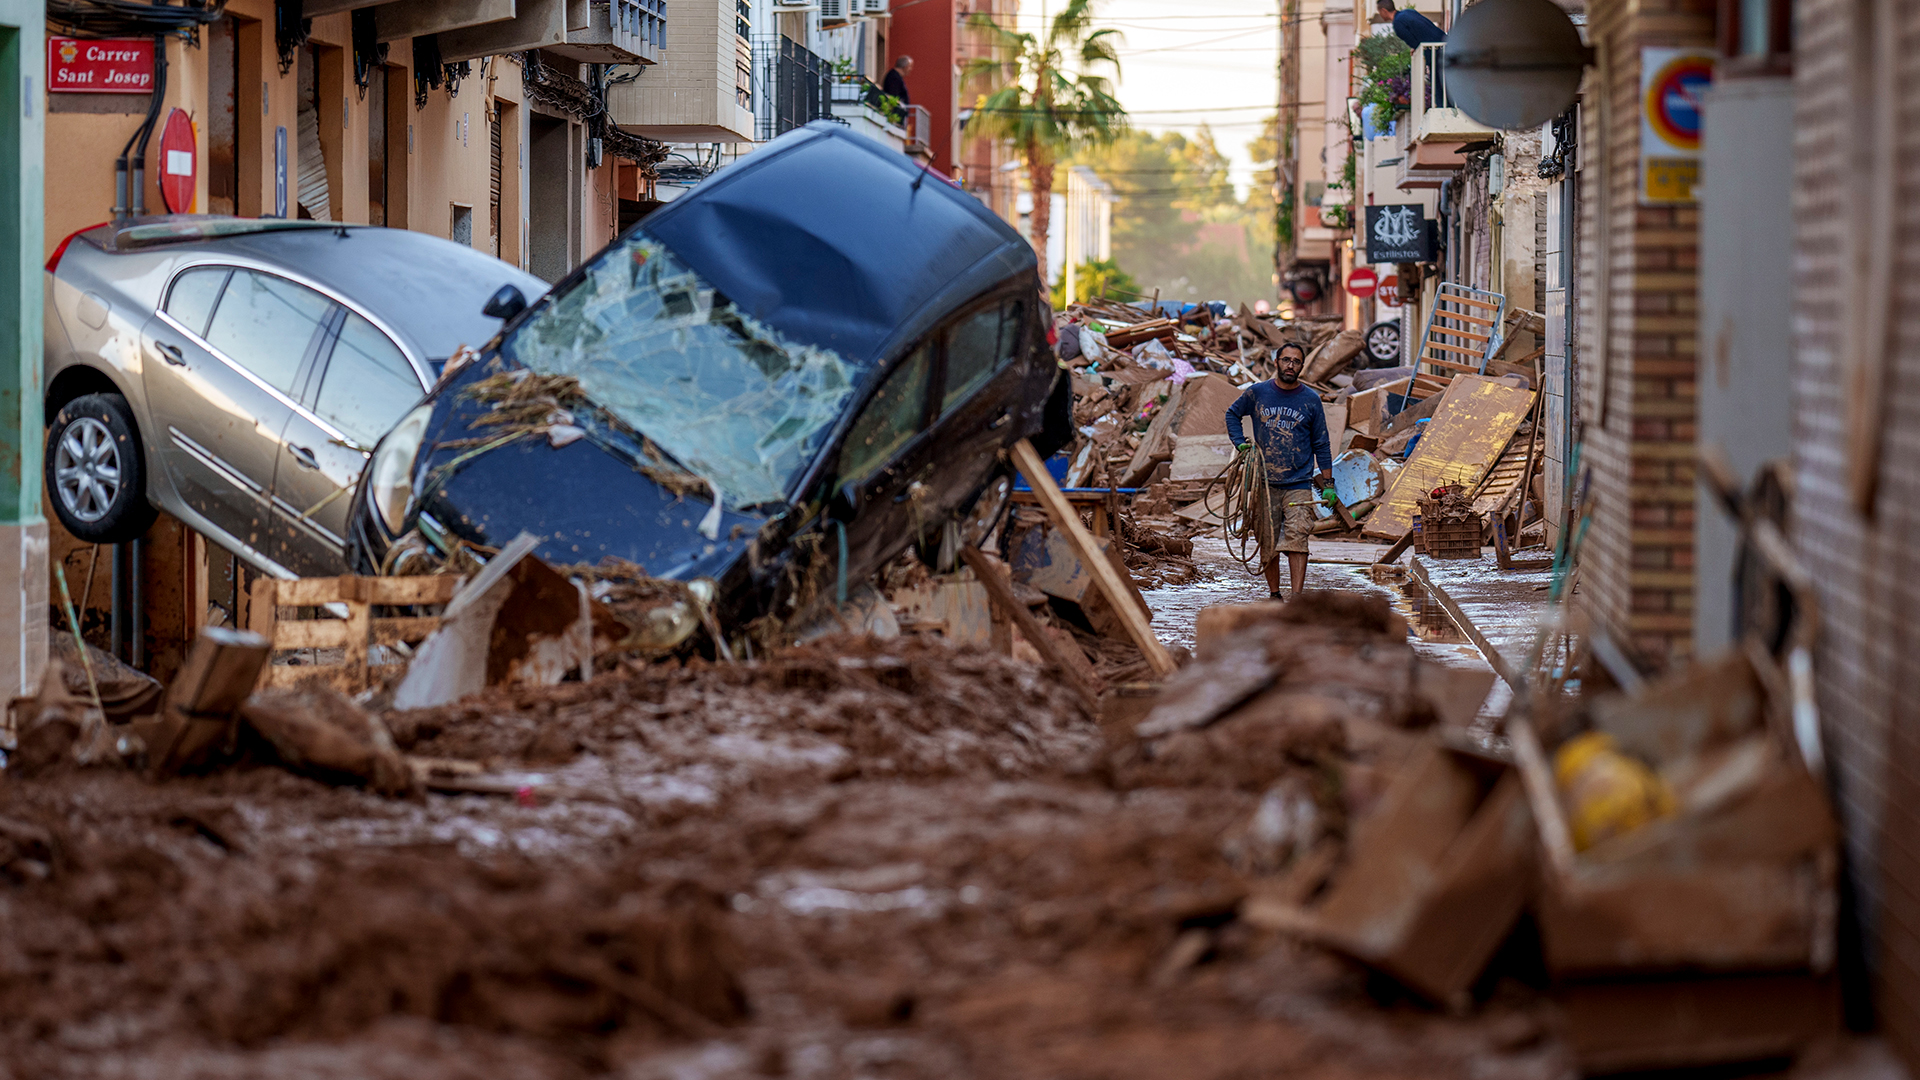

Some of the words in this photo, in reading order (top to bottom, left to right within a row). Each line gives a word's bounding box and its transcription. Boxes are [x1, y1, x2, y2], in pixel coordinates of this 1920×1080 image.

[86, 46, 140, 62] Carrer
[57, 68, 94, 83] Sant
[104, 69, 150, 87] Josep
[1380, 286, 1398, 296] STO
